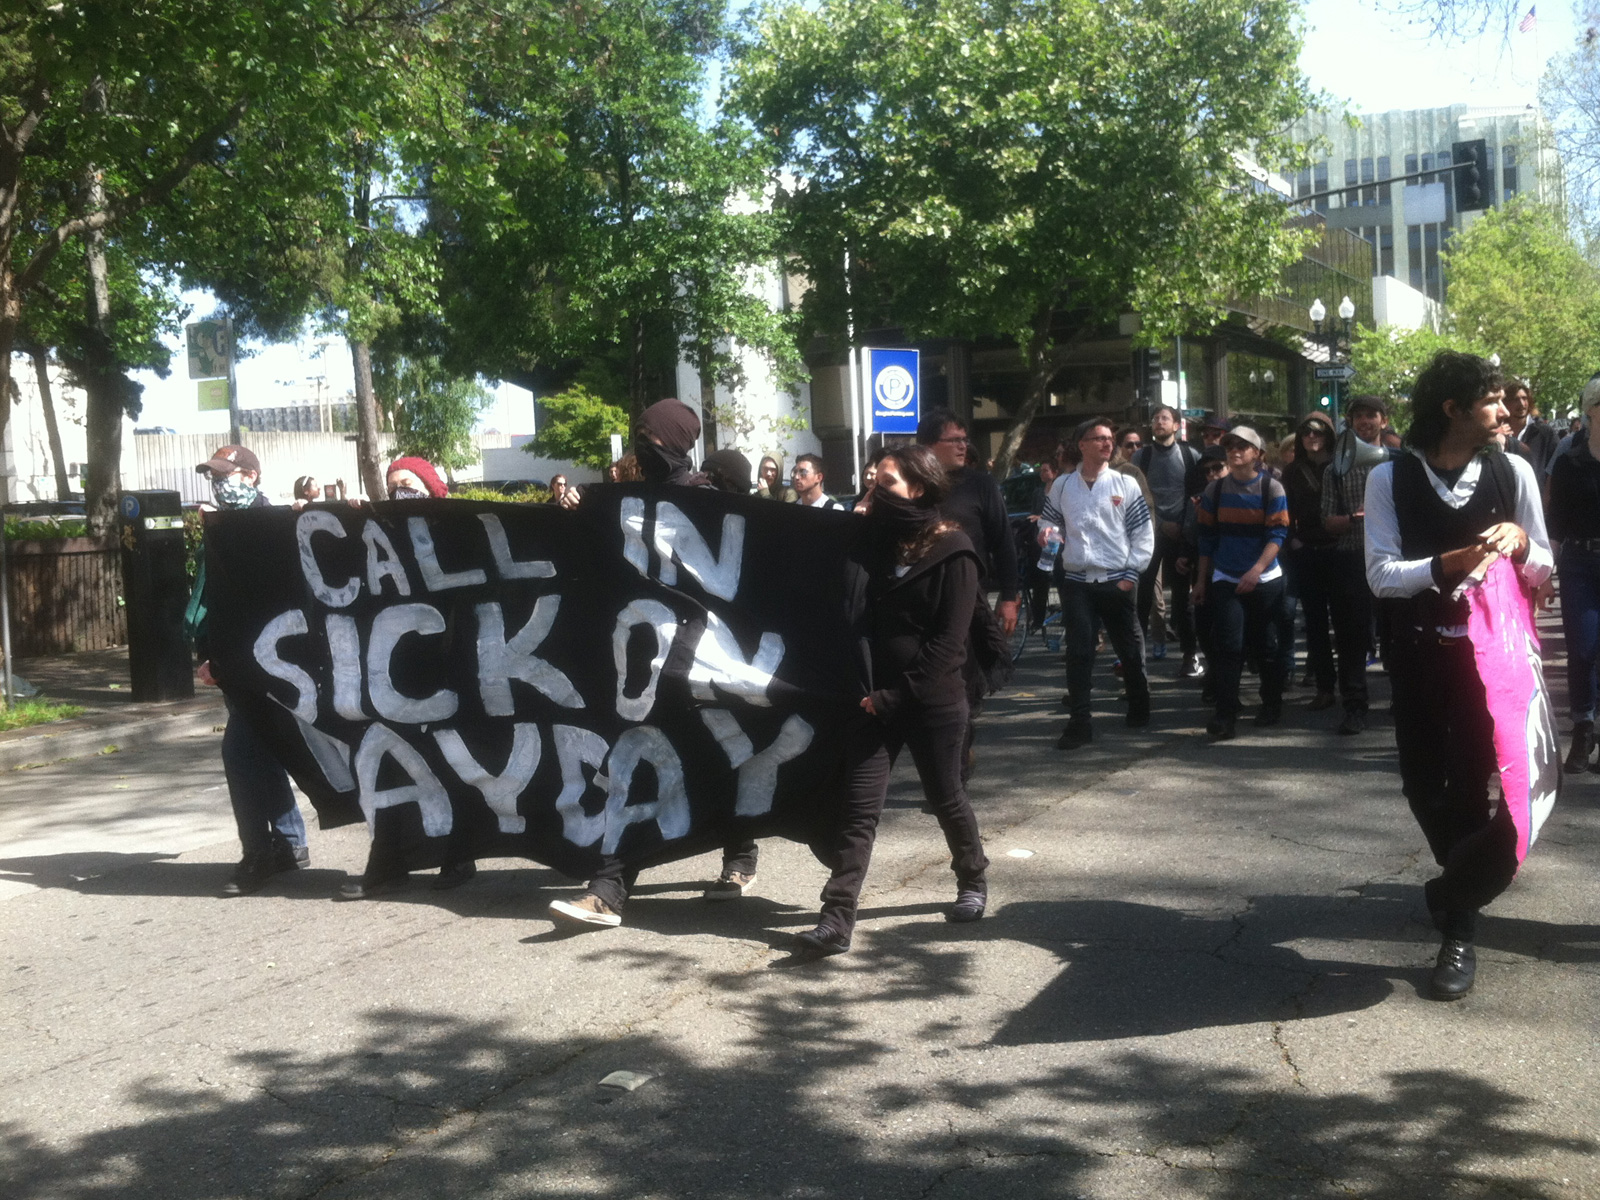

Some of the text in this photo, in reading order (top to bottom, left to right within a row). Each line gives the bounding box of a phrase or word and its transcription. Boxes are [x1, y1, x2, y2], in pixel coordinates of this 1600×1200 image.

[125, 500, 134, 516] P
[296, 497, 745, 608] CALL IN
[253, 594, 786, 726] SICK ON
